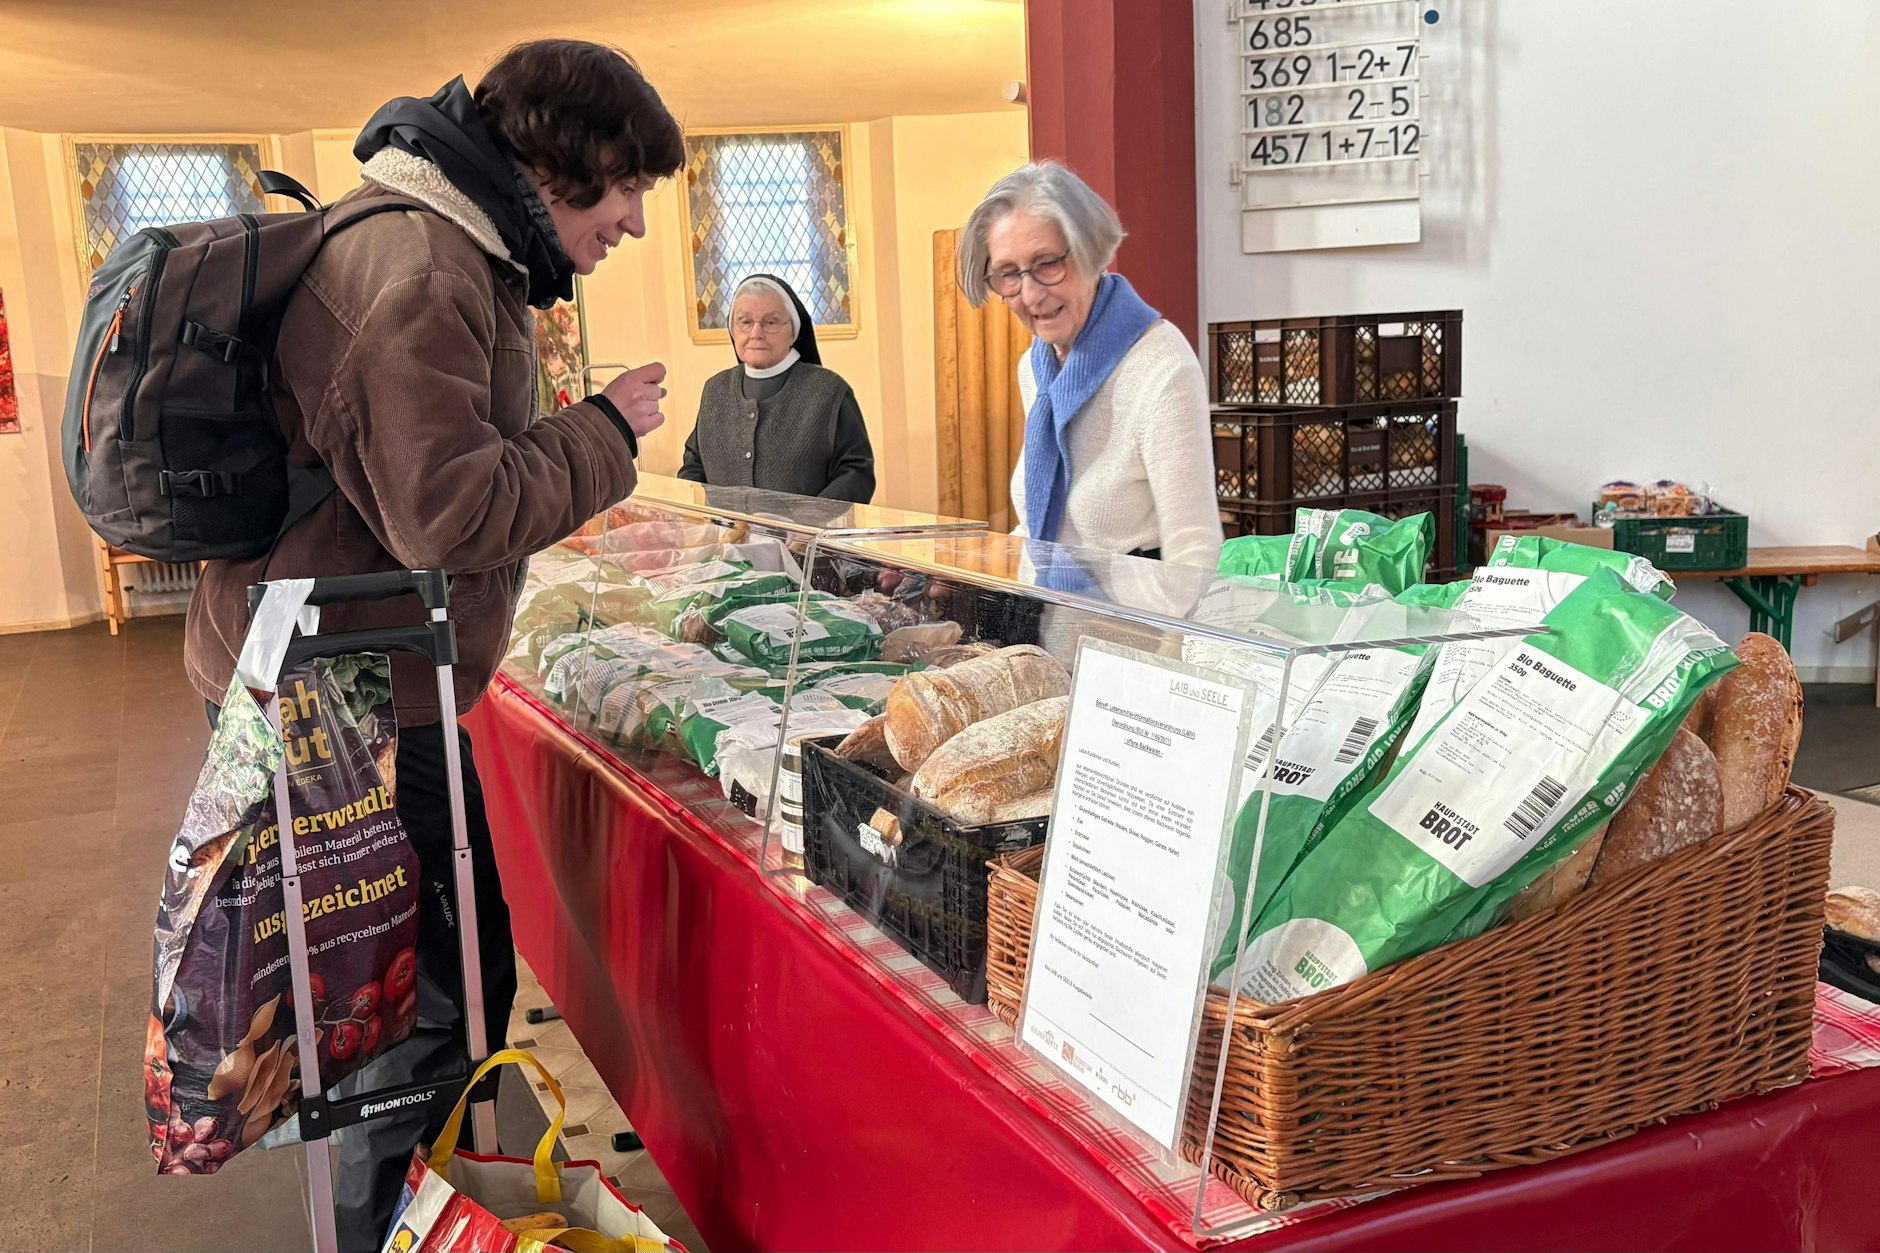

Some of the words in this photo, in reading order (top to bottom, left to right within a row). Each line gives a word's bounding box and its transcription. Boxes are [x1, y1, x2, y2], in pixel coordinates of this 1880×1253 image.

[1250, 16, 1312, 51] 685
[1250, 55, 1311, 90] 369
[1248, 94, 1304, 128] 182
[1250, 132, 1310, 165] 457
[1486, 575, 1530, 587] Baguette
[1507, 662, 1528, 677] 350g
[1515, 652, 1535, 667] Bio
[1530, 661, 1579, 692] Baguette
[1169, 679, 1188, 695] LAIB
[1200, 688, 1228, 708] SEELE
[1417, 809, 1473, 852] BROT
[1432, 800, 1480, 835] HAUPTSTADT
[318, 852, 342, 871] sich
[319, 936, 337, 953] aus
[336, 921, 391, 947] recyceltem
[1305, 950, 1338, 981] HAUPTSTADT
